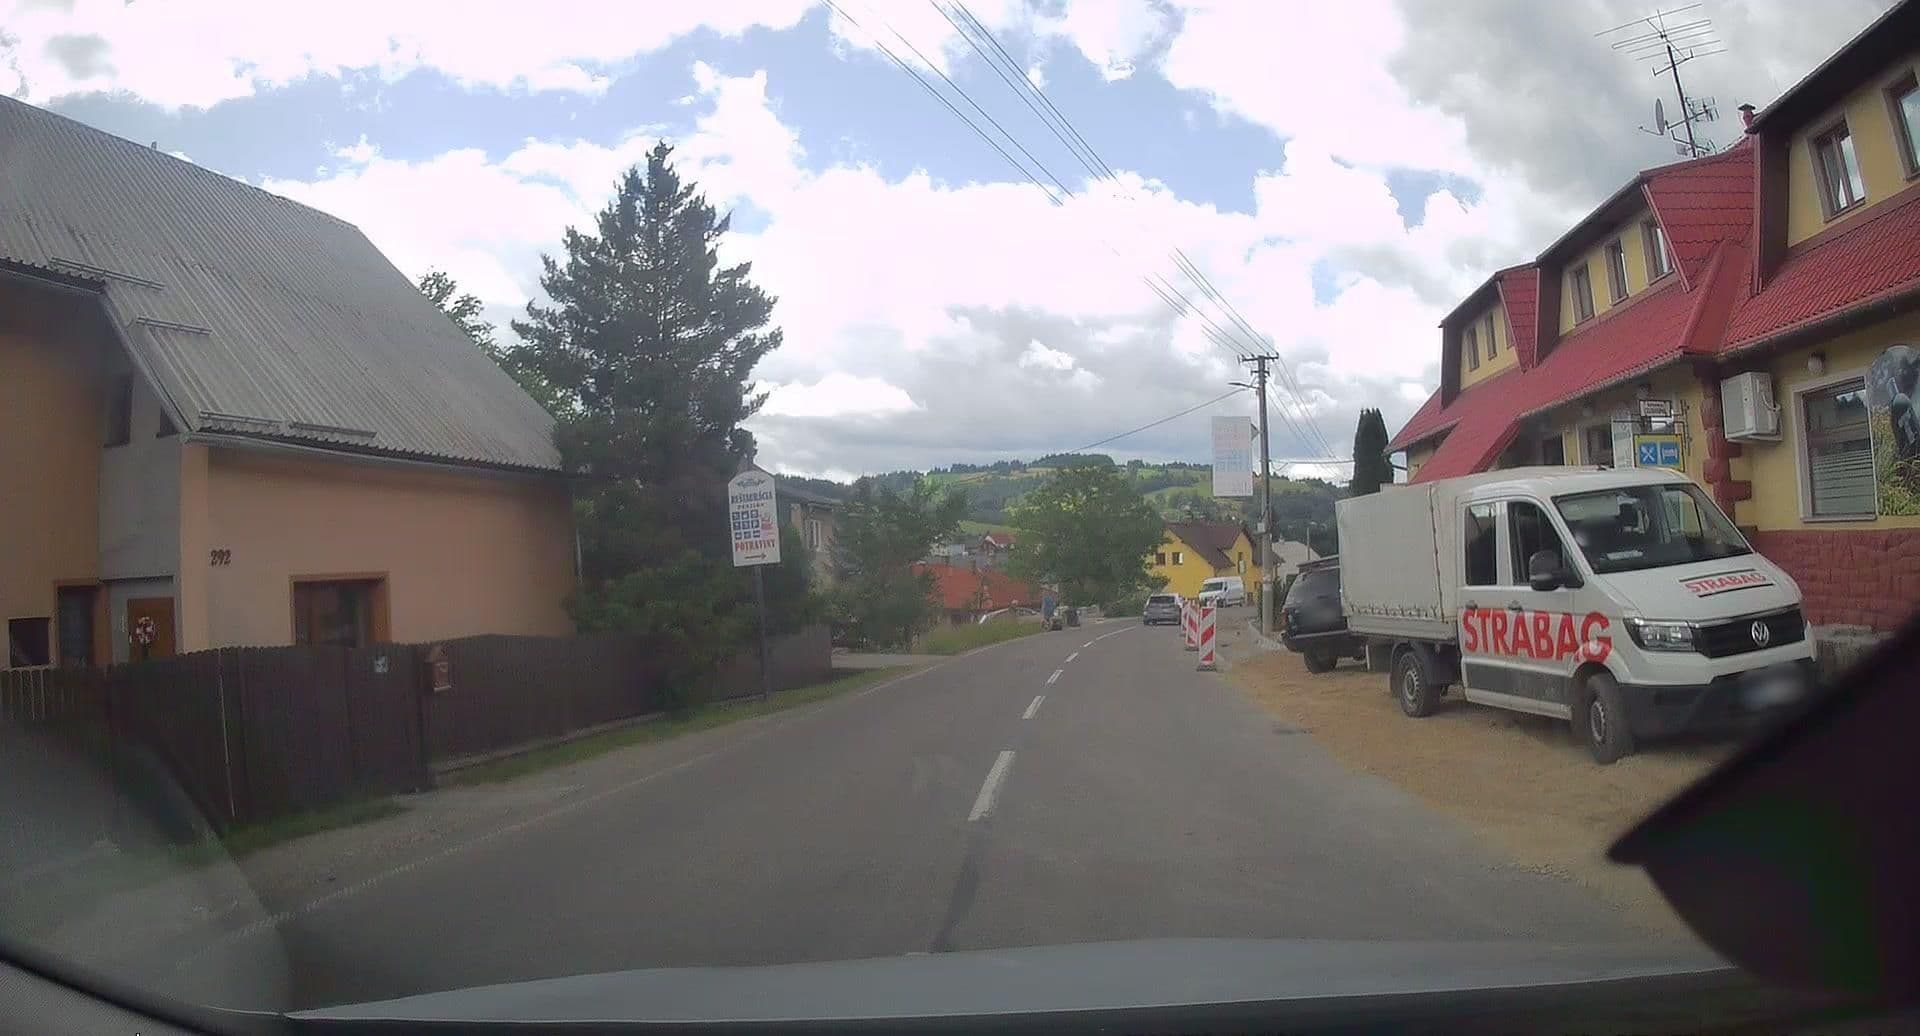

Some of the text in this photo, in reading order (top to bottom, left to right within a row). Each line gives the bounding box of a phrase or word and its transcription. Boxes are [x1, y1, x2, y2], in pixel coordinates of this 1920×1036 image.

[210, 549, 231, 567] 292
[1685, 573, 1766, 593] STRABAG
[1463, 608, 1612, 664] STRABAG
